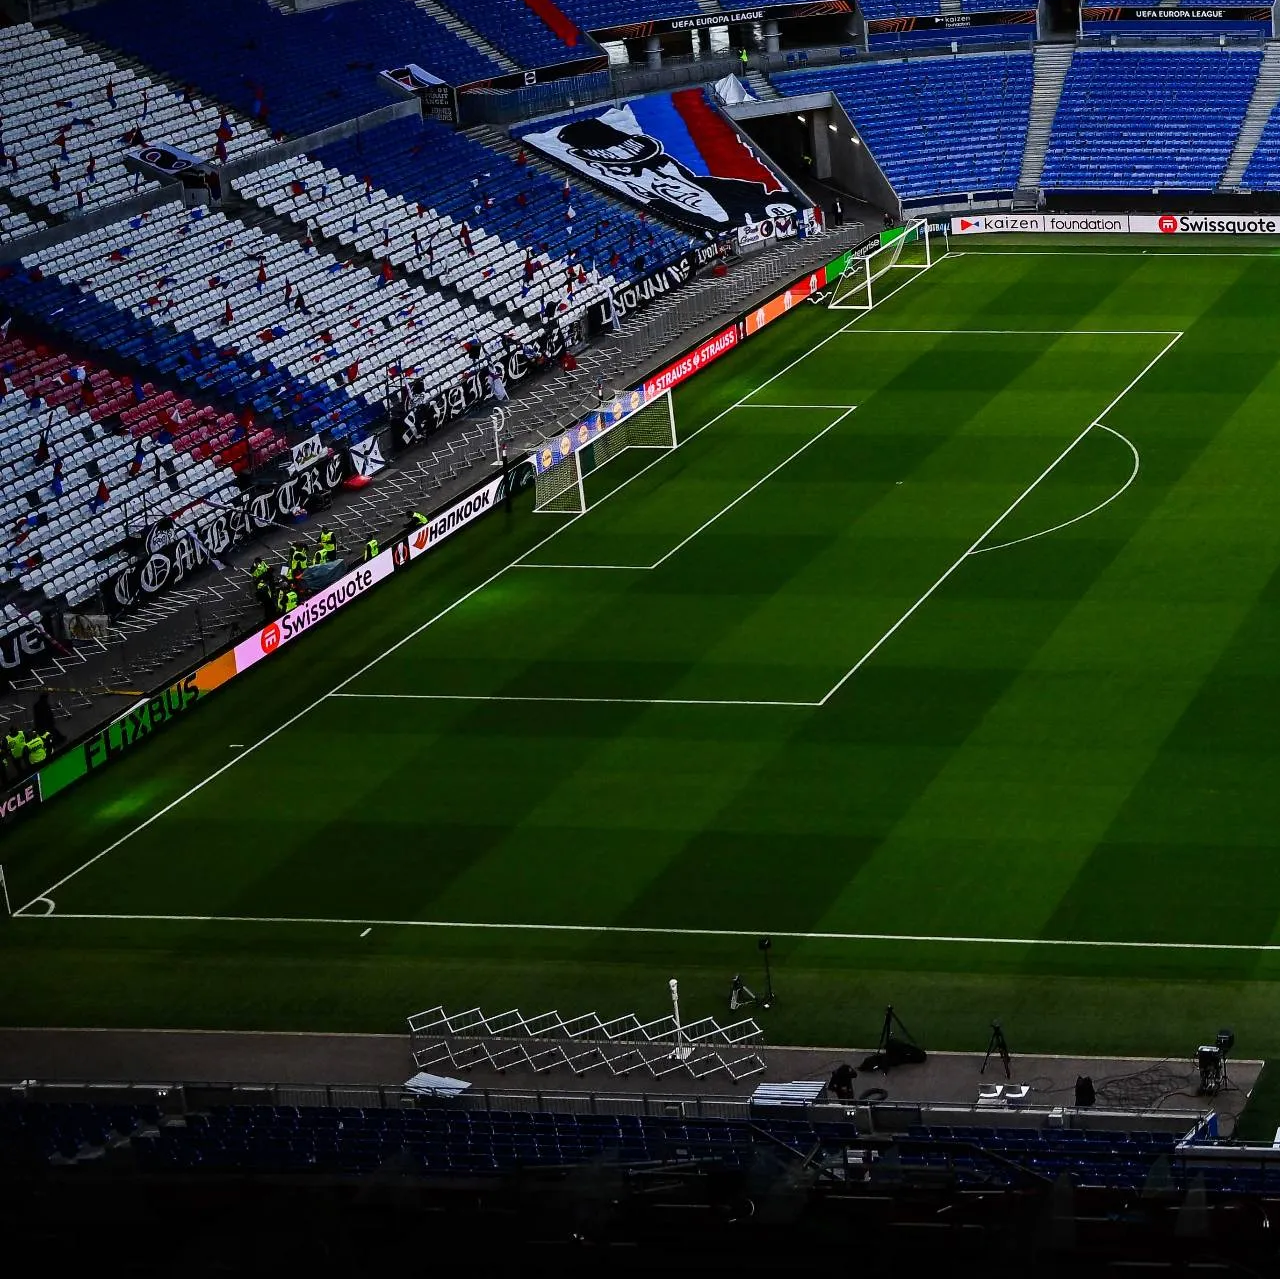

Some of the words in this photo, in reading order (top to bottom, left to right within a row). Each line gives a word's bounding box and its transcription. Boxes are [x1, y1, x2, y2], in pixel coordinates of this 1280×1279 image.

[672, 20, 695, 29] UEFA
[696, 15, 729, 26] EUROPA
[731, 11, 763, 22] LEAGUE
[1136, 10, 1156, 18] UEFA
[1159, 10, 1189, 18] EUROPA
[1192, 10, 1223, 18] LEAGUE
[984, 217, 1039, 230] kaizen
[1051, 218, 1121, 230] foundation
[1180, 216, 1276, 235] Swissquote
[846, 239, 880, 266] terprise
[656, 359, 692, 391] STRAUSS
[701, 331, 734, 362] STRAUSS
[281, 570, 372, 639] Swissquote
